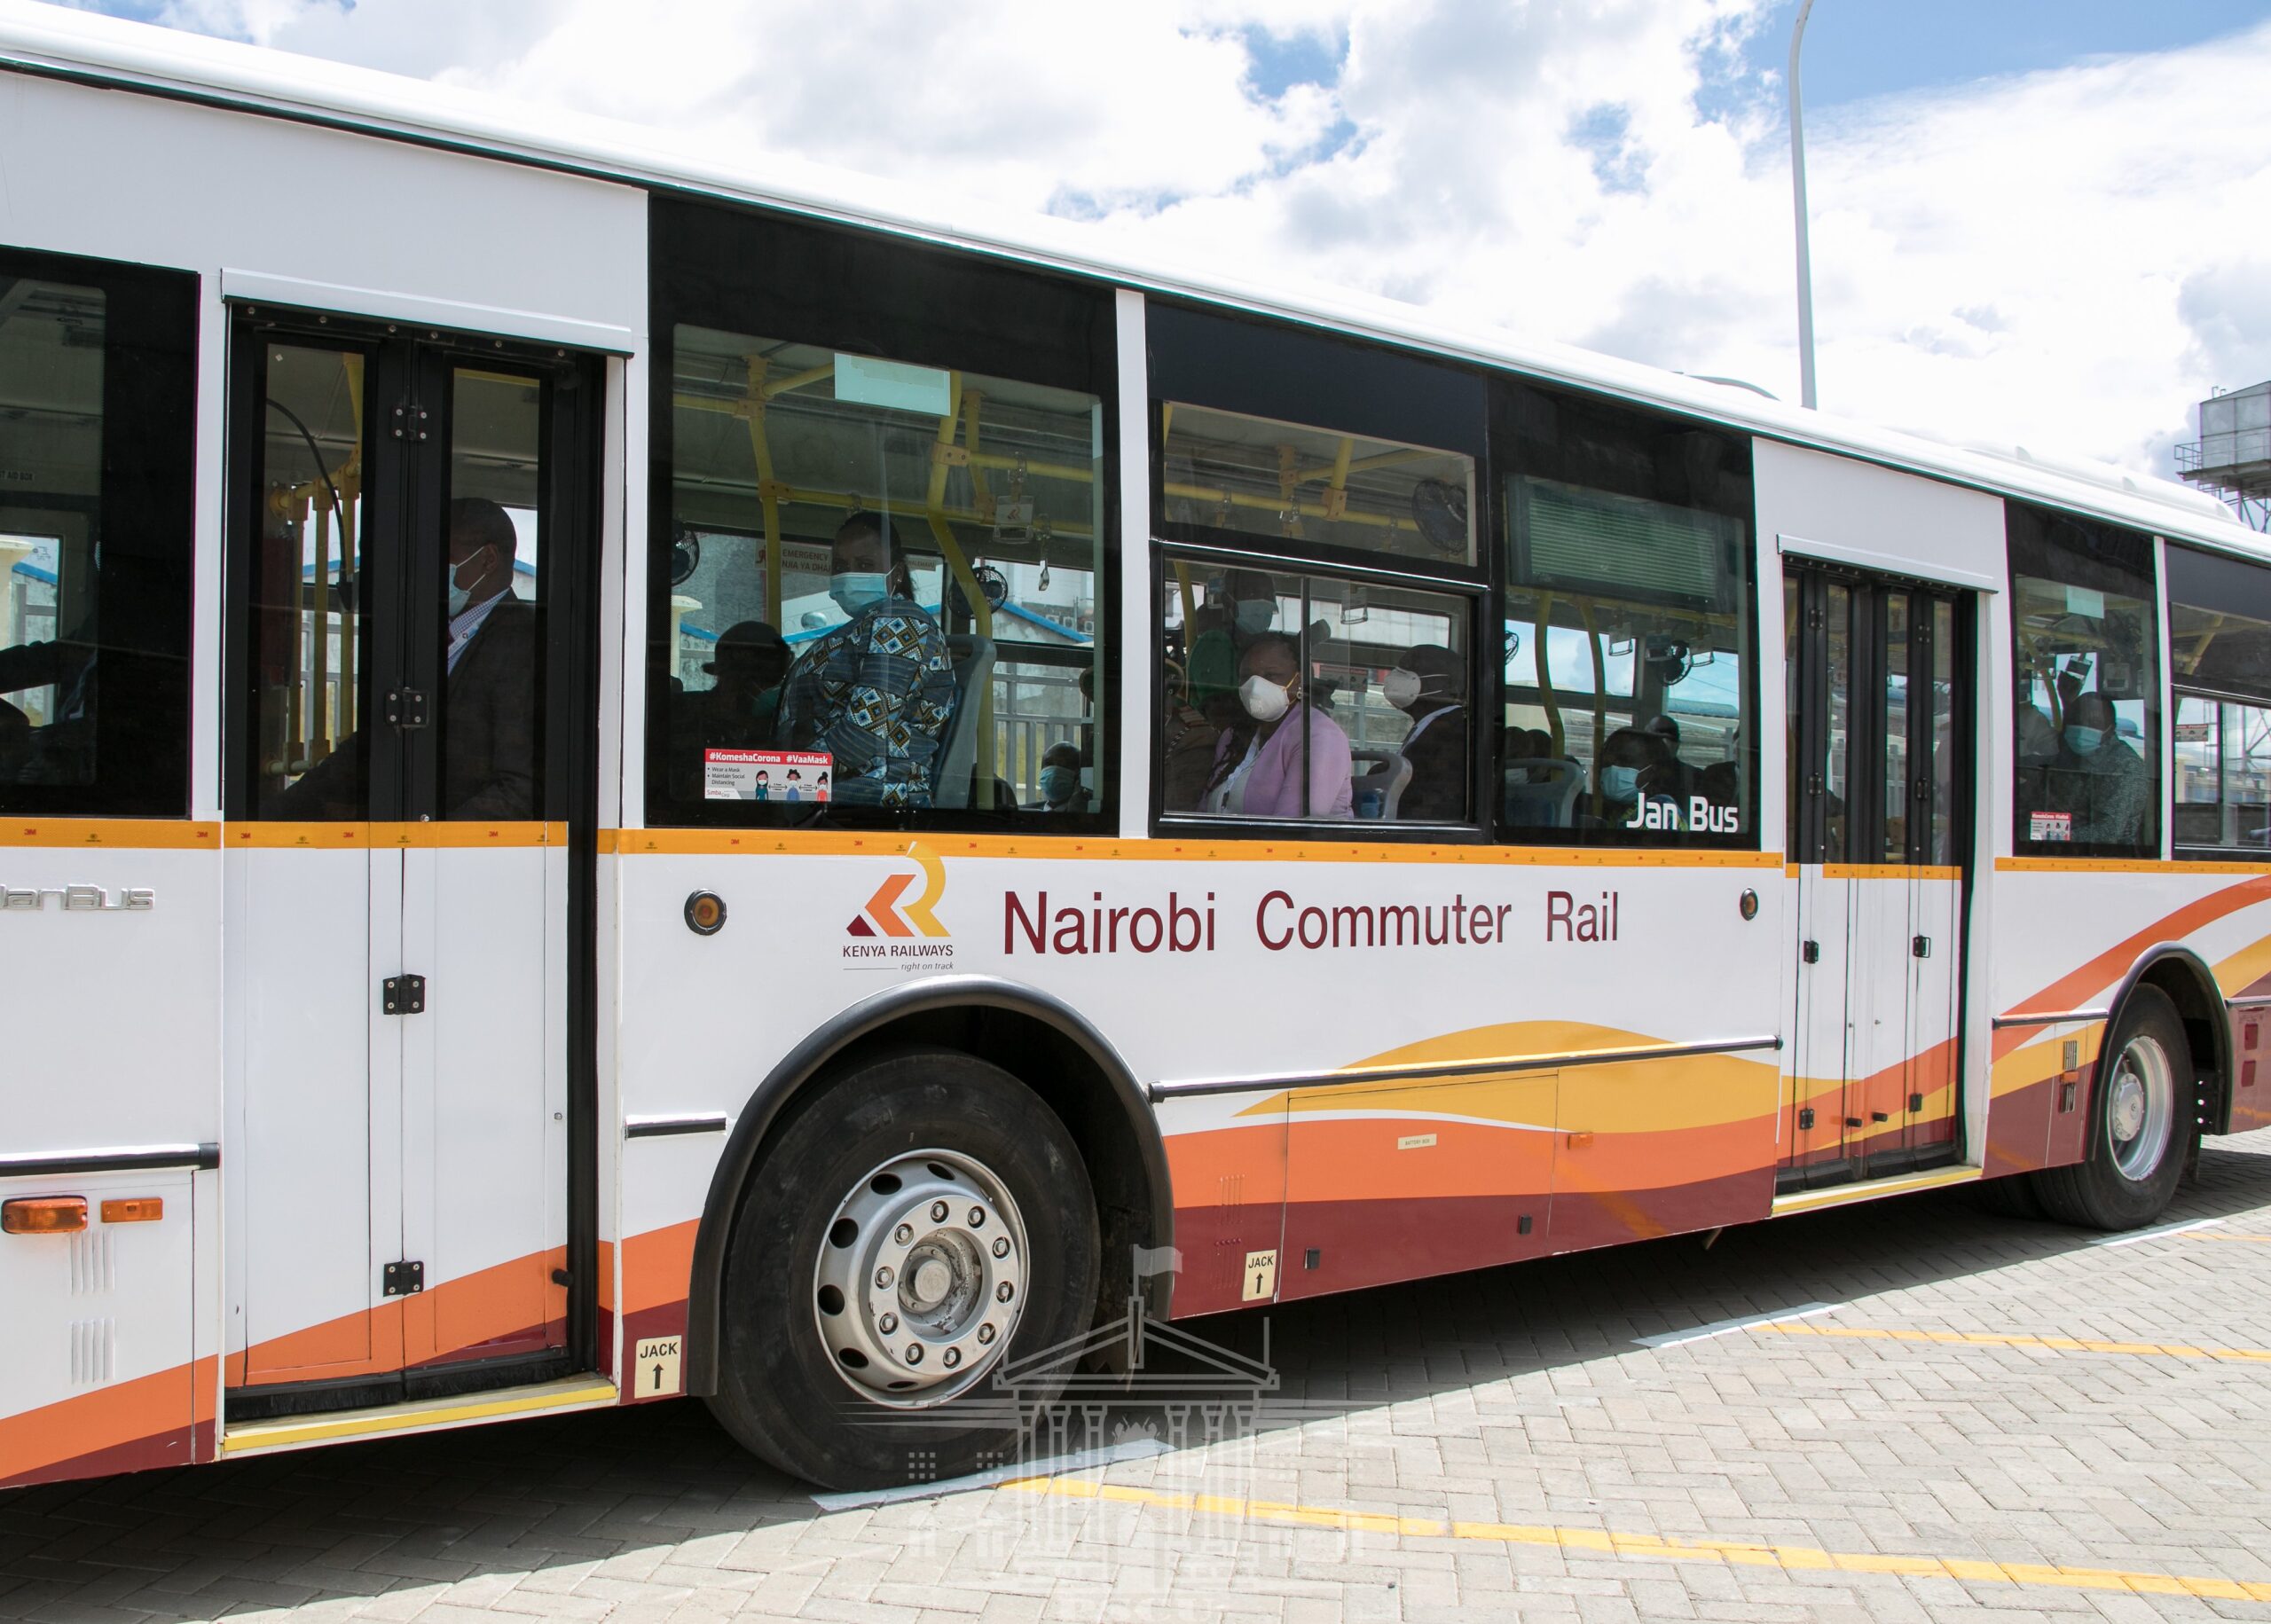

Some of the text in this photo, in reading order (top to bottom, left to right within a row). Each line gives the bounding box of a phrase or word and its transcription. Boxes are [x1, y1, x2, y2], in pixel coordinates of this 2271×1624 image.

[782, 549, 829, 561] EMERGENCY
[800, 561, 811, 570] YA
[709, 752, 829, 765] #KomeshaCorona #VaaMask
[1626, 792, 1739, 833] Jan Bus
[1004, 890, 1619, 955] Nairobi Commuter Rail
[843, 944, 954, 958] KENYA RAILWAYS
[901, 962, 920, 972] right
[934, 961, 955, 971] track
[1248, 1255, 1274, 1269] JACK
[640, 1341, 678, 1359] JACK
